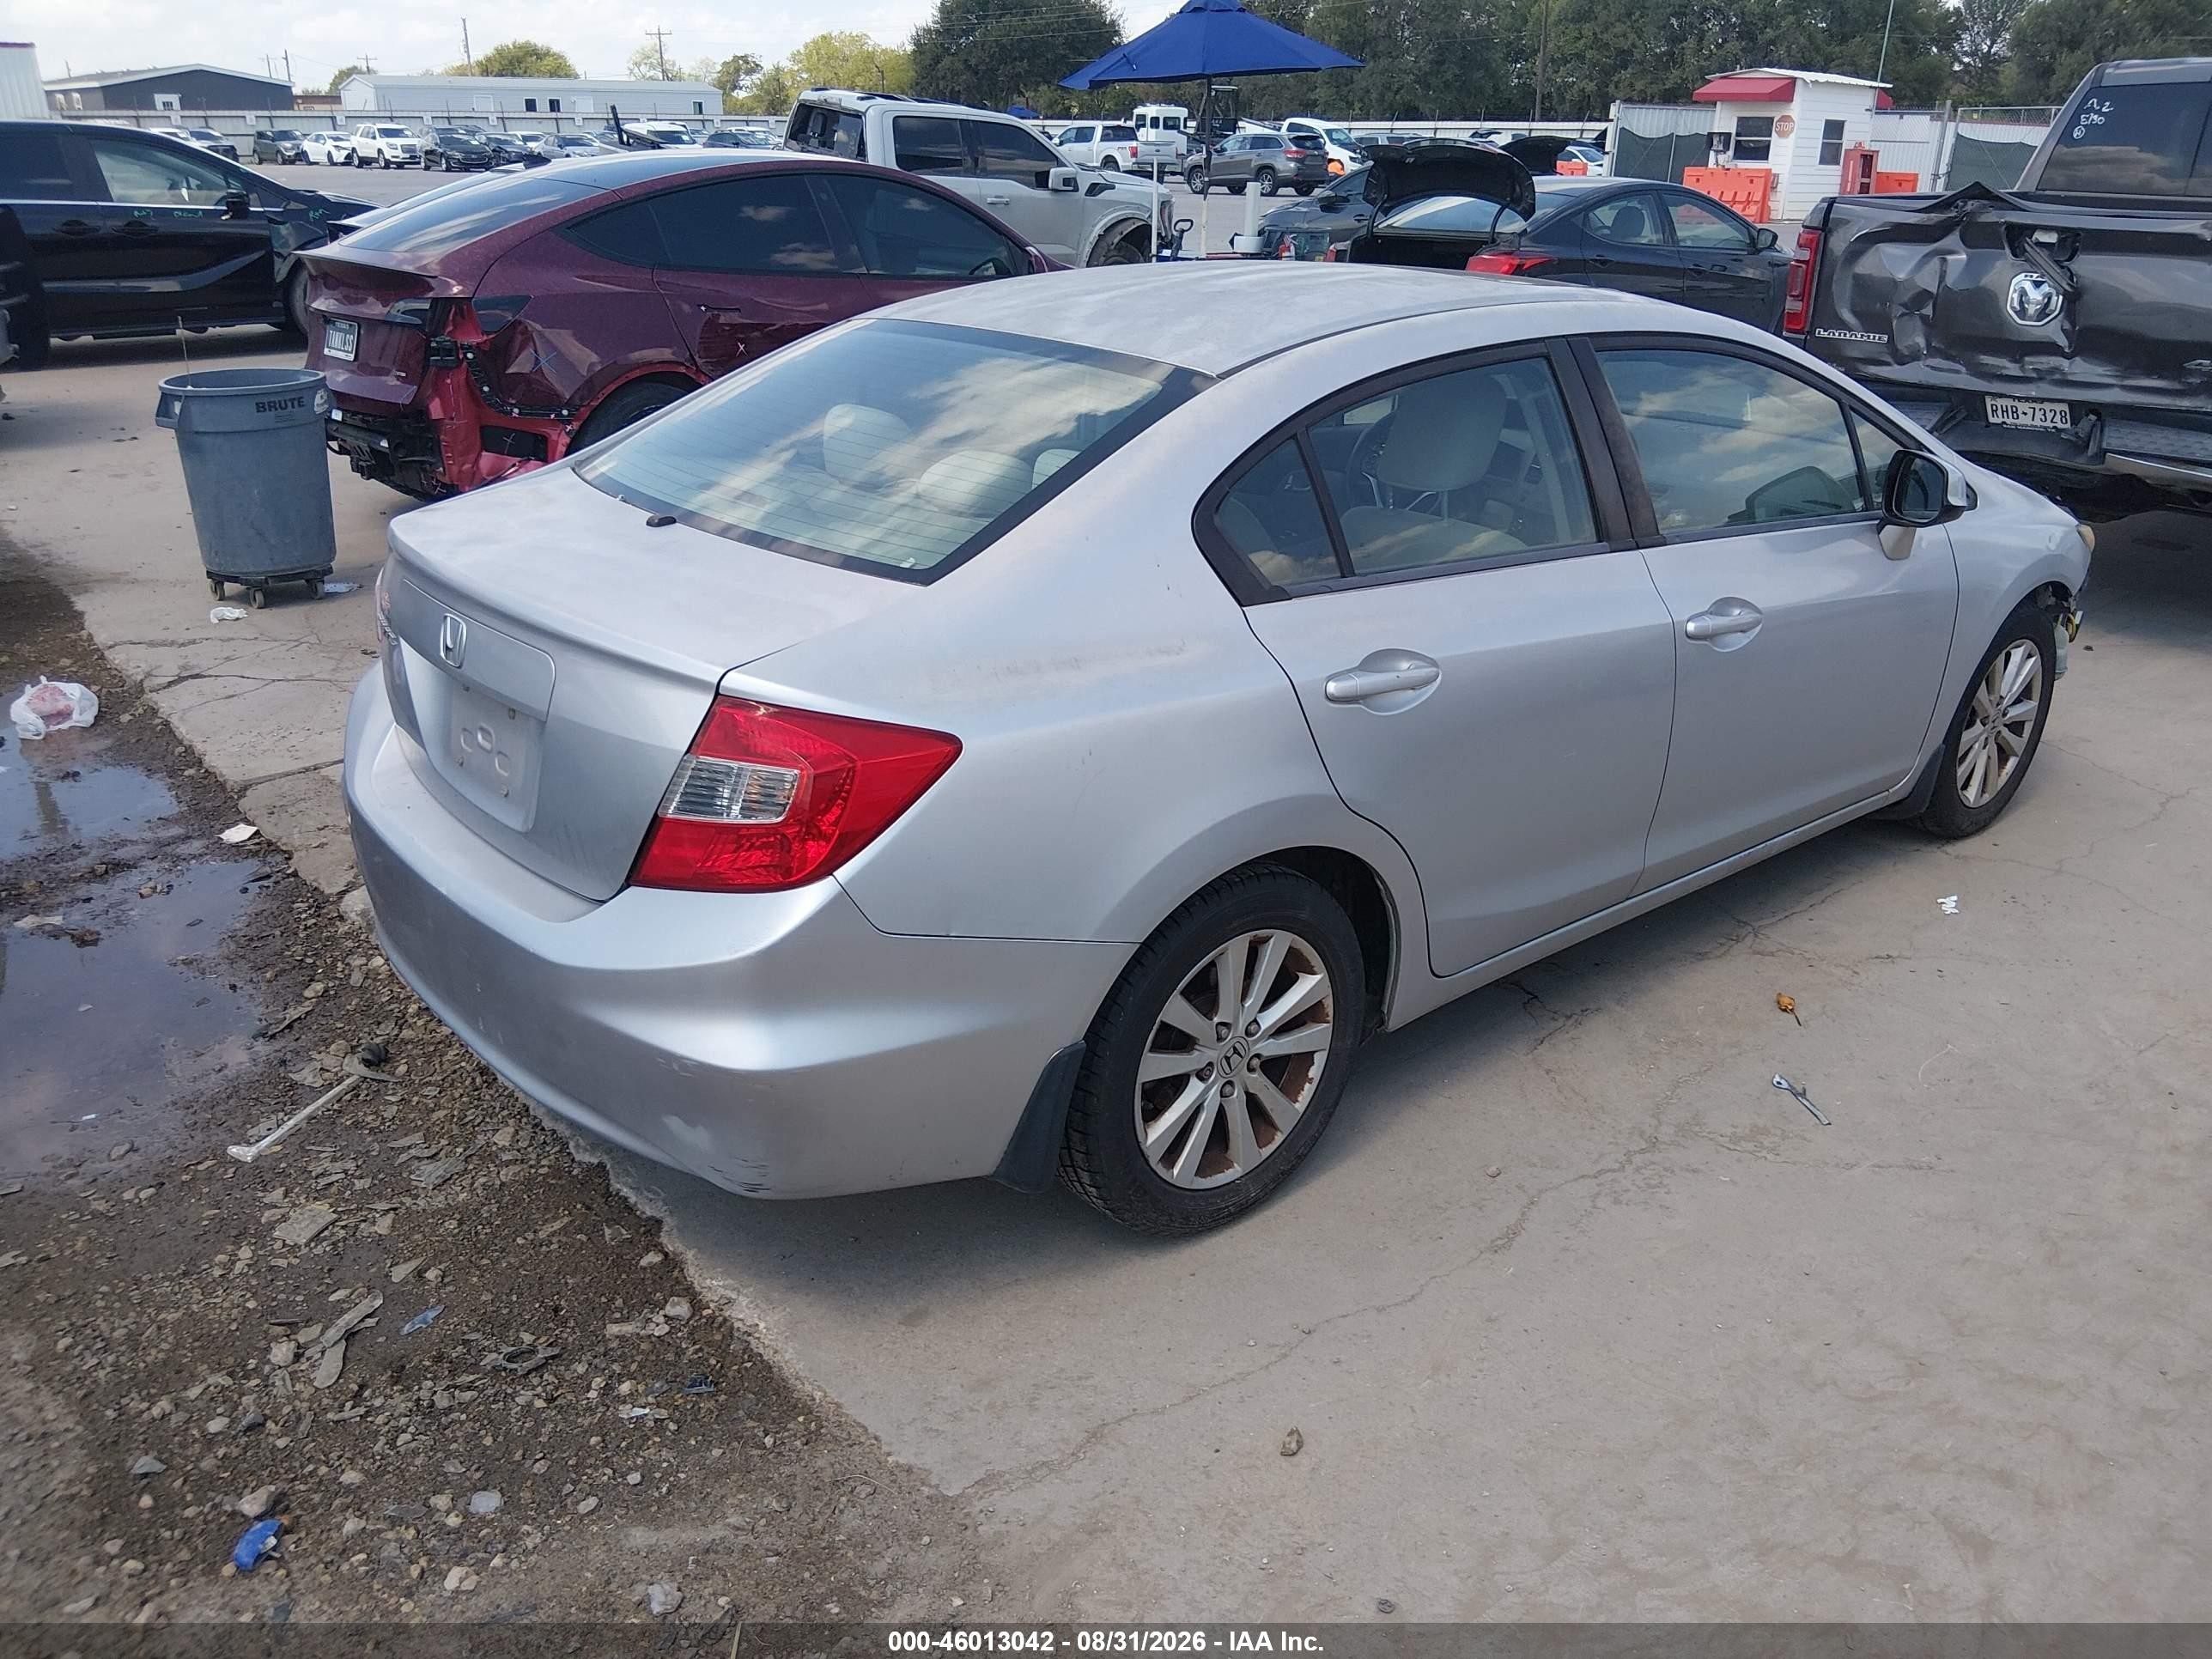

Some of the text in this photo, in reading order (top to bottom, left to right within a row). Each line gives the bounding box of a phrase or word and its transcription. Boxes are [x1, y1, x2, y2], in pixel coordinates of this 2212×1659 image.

[1775, 122, 1795, 131] STOP
[1815, 328, 1889, 343] LARAMIE
[255, 396, 306, 413] BRUTE
